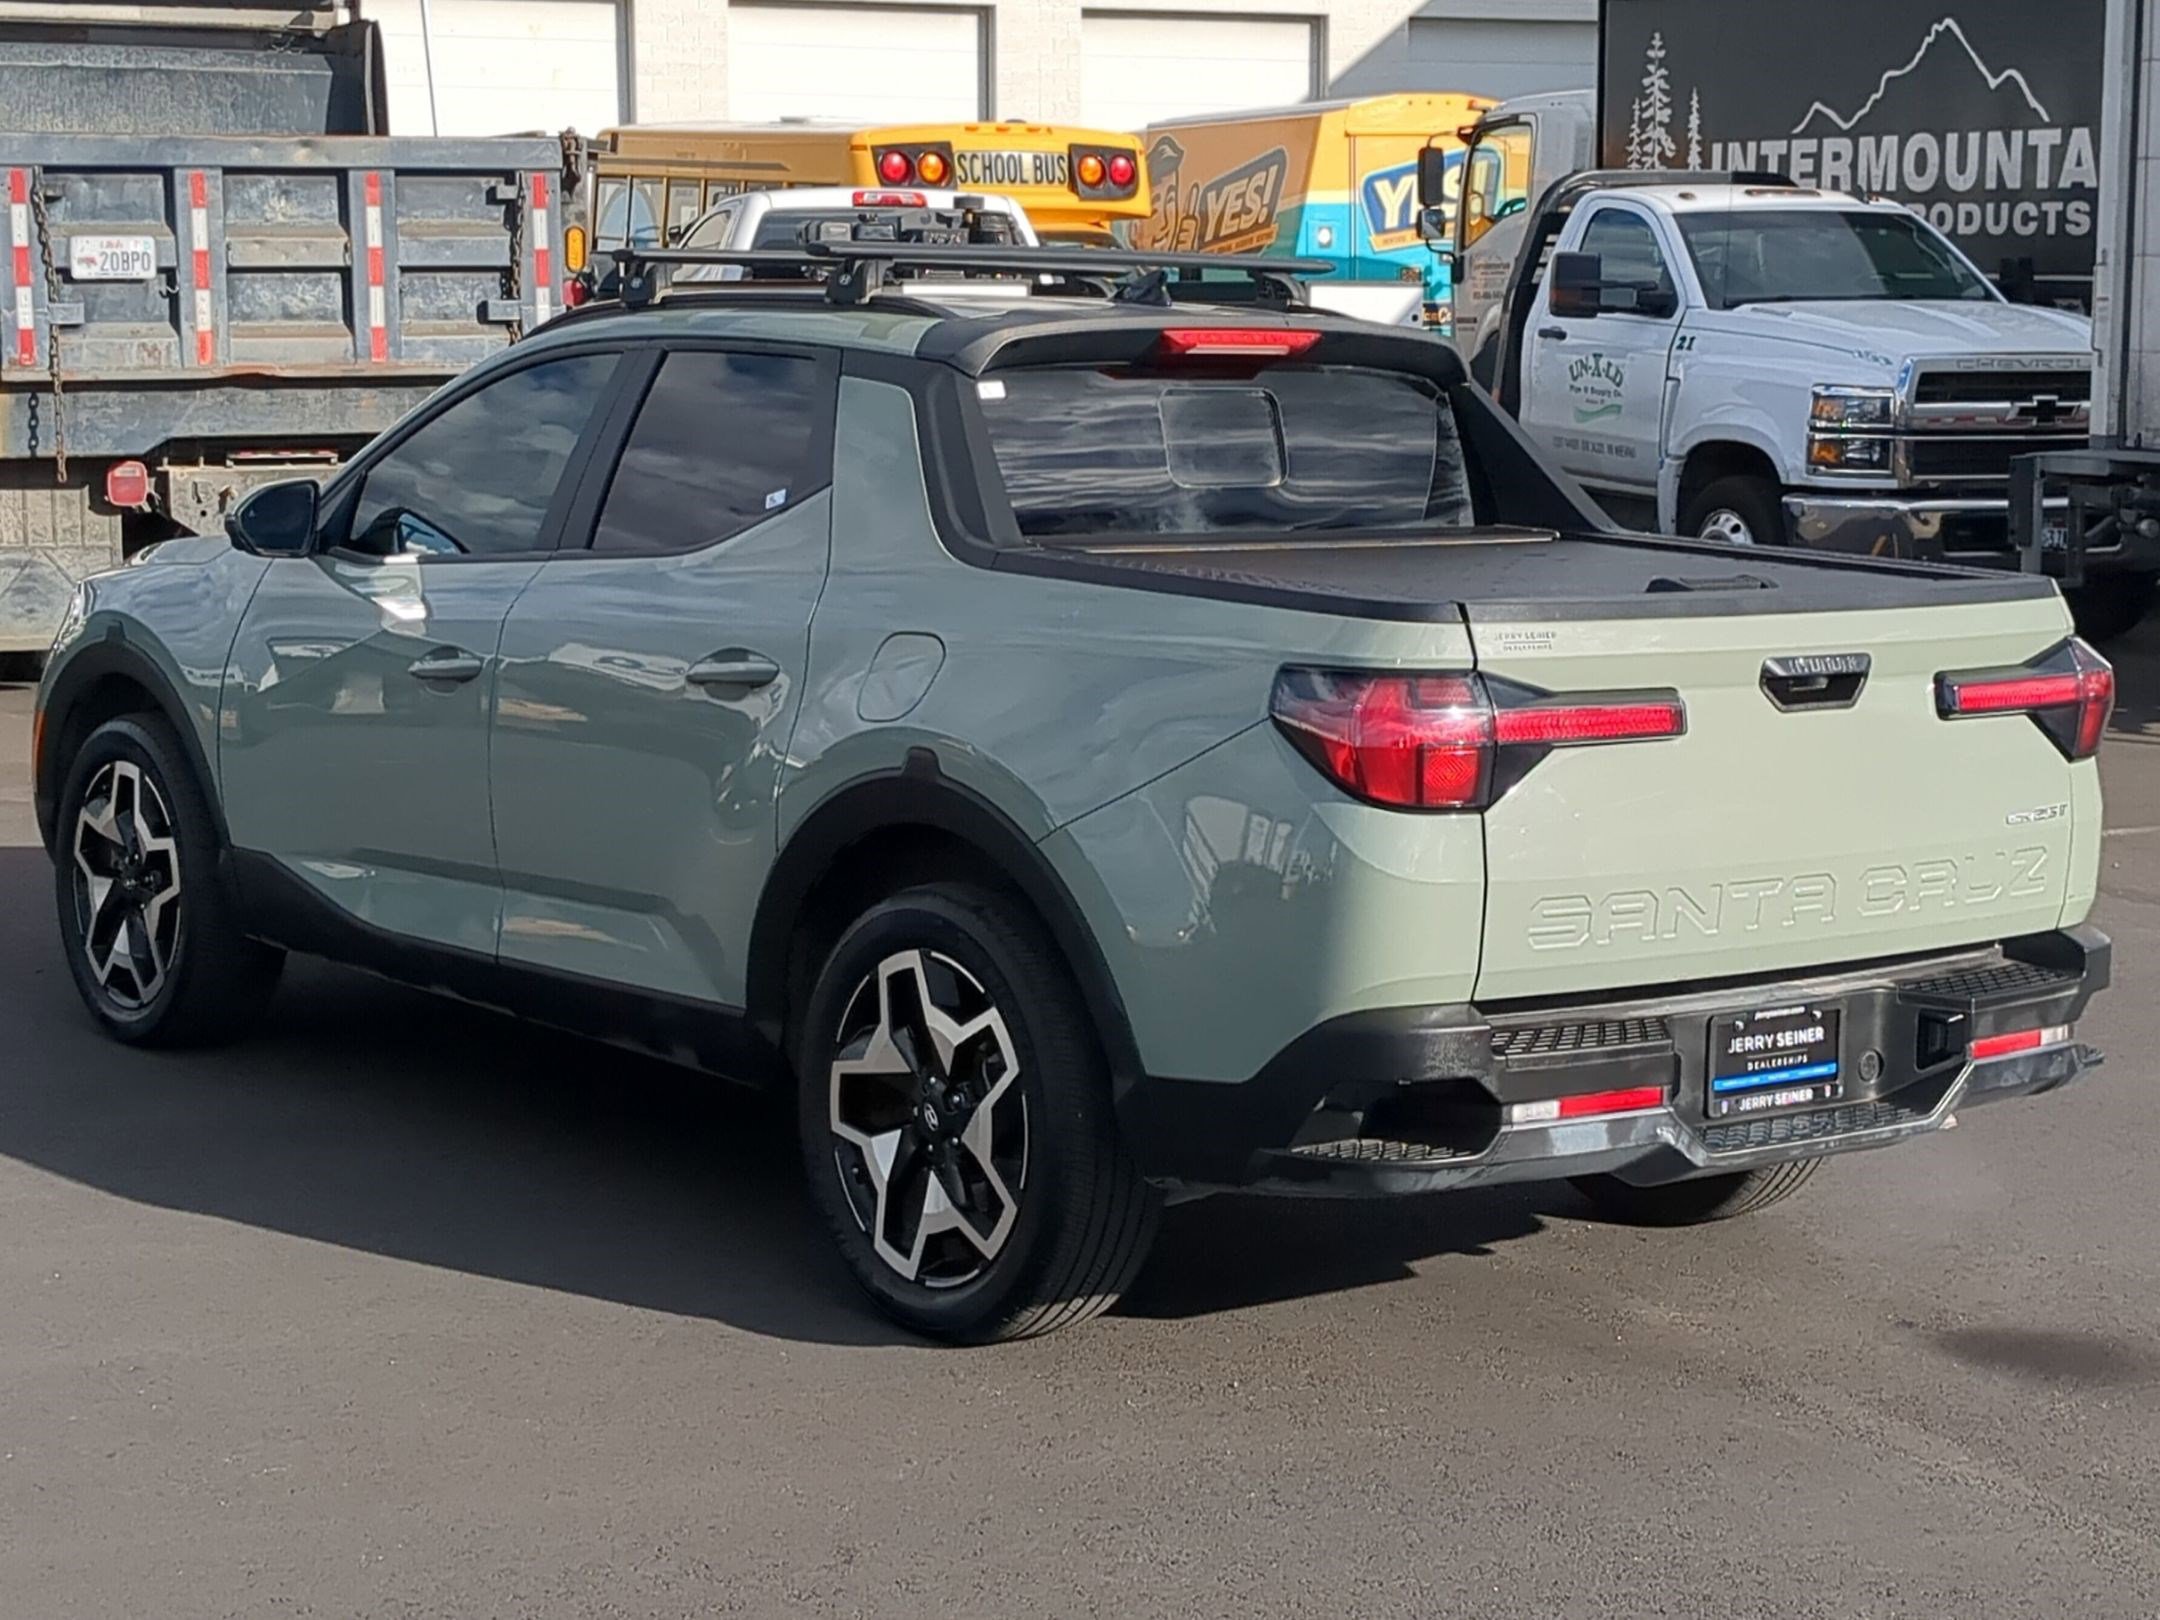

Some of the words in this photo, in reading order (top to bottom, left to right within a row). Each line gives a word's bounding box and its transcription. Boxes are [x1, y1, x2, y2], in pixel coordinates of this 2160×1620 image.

[957, 153, 1028, 184] SCHOOL
[1033, 154, 1067, 184] BUS
[1204, 163, 1279, 243] YES!
[1676, 336, 1697, 351] 21
[1528, 871, 1837, 950] SANTA
[1856, 845, 2048, 918] CRUZ
[1727, 1032, 1775, 1054] JERRY
[1775, 1026, 1825, 1048] SEINER
[1747, 1054, 1808, 1071] DEALERSHIPS
[1738, 1093, 1774, 1112] JERRY
[1774, 1087, 1814, 1106] SEINER
